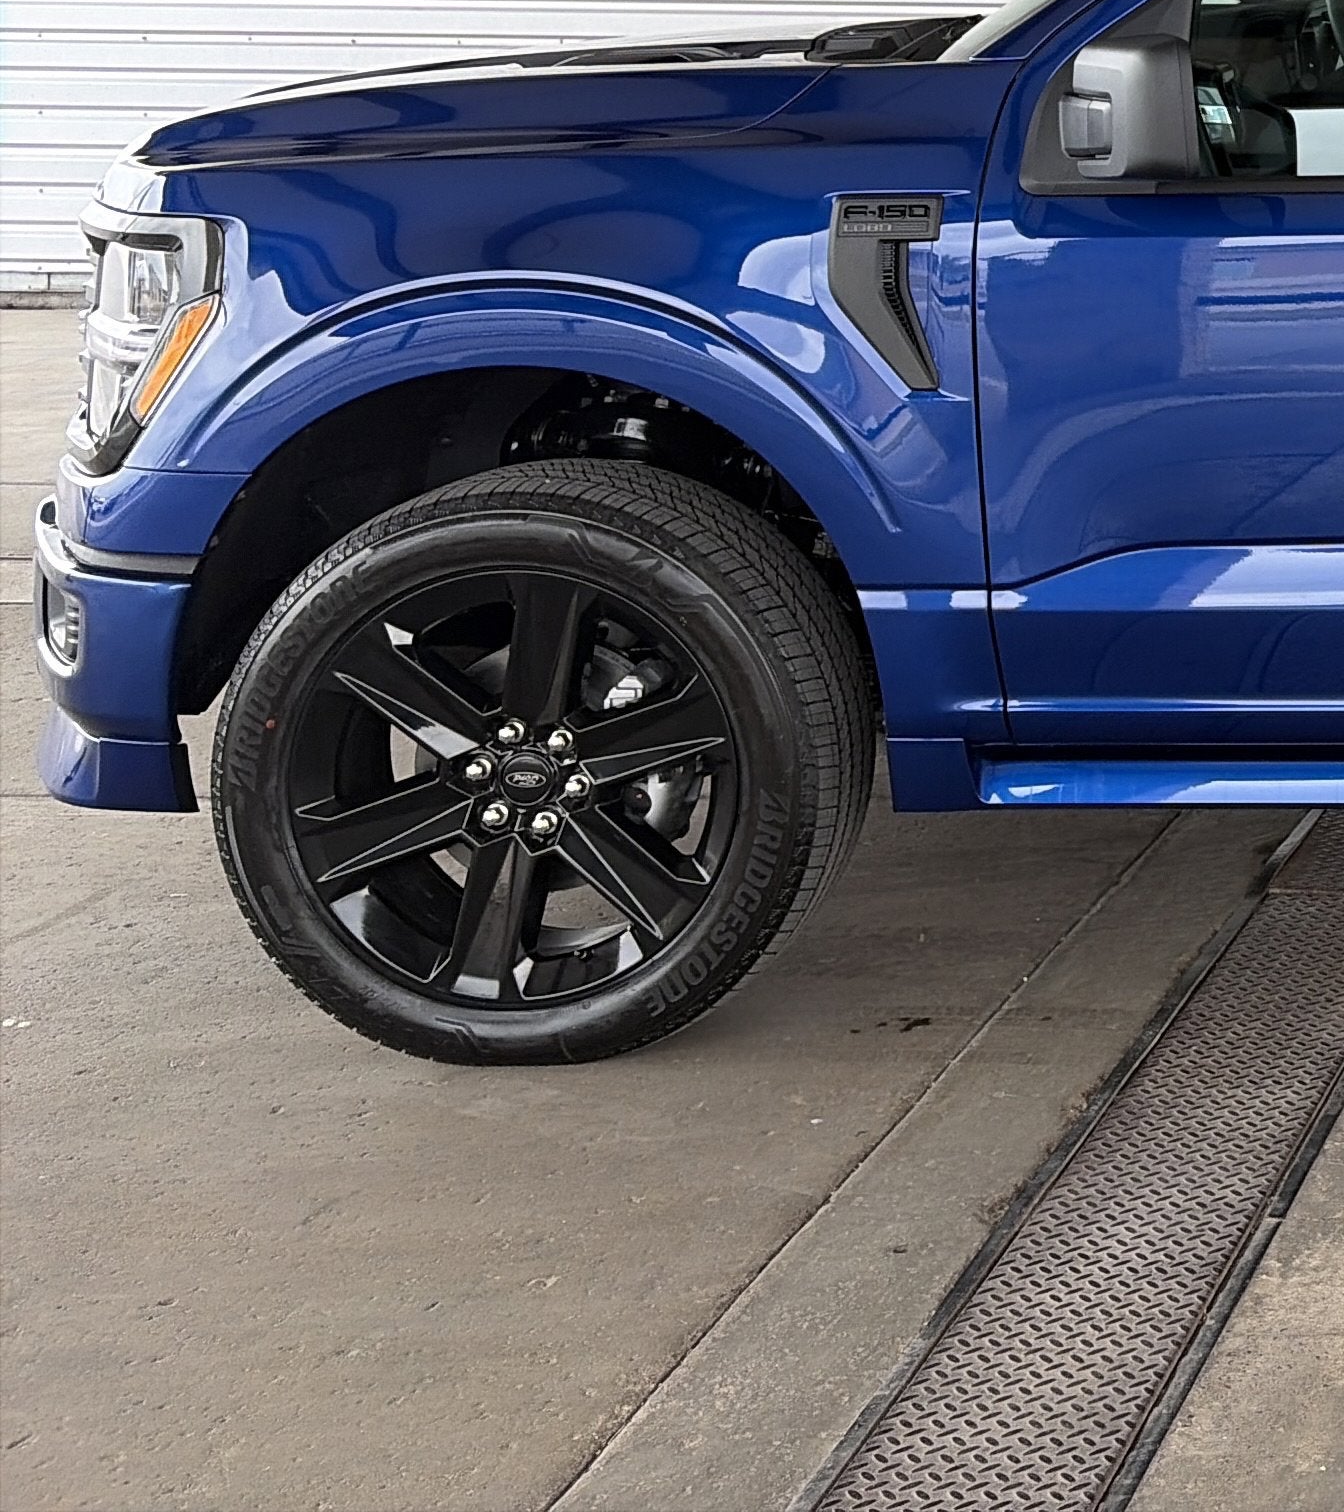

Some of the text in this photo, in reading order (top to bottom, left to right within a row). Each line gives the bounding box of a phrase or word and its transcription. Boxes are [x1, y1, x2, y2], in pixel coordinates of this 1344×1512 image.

[843, 204, 931, 220] F-150
[843, 223, 892, 232] LOBO
[228, 560, 375, 791] BRIDGESTONE
[643, 788, 791, 1018] BRIDGESTONE
